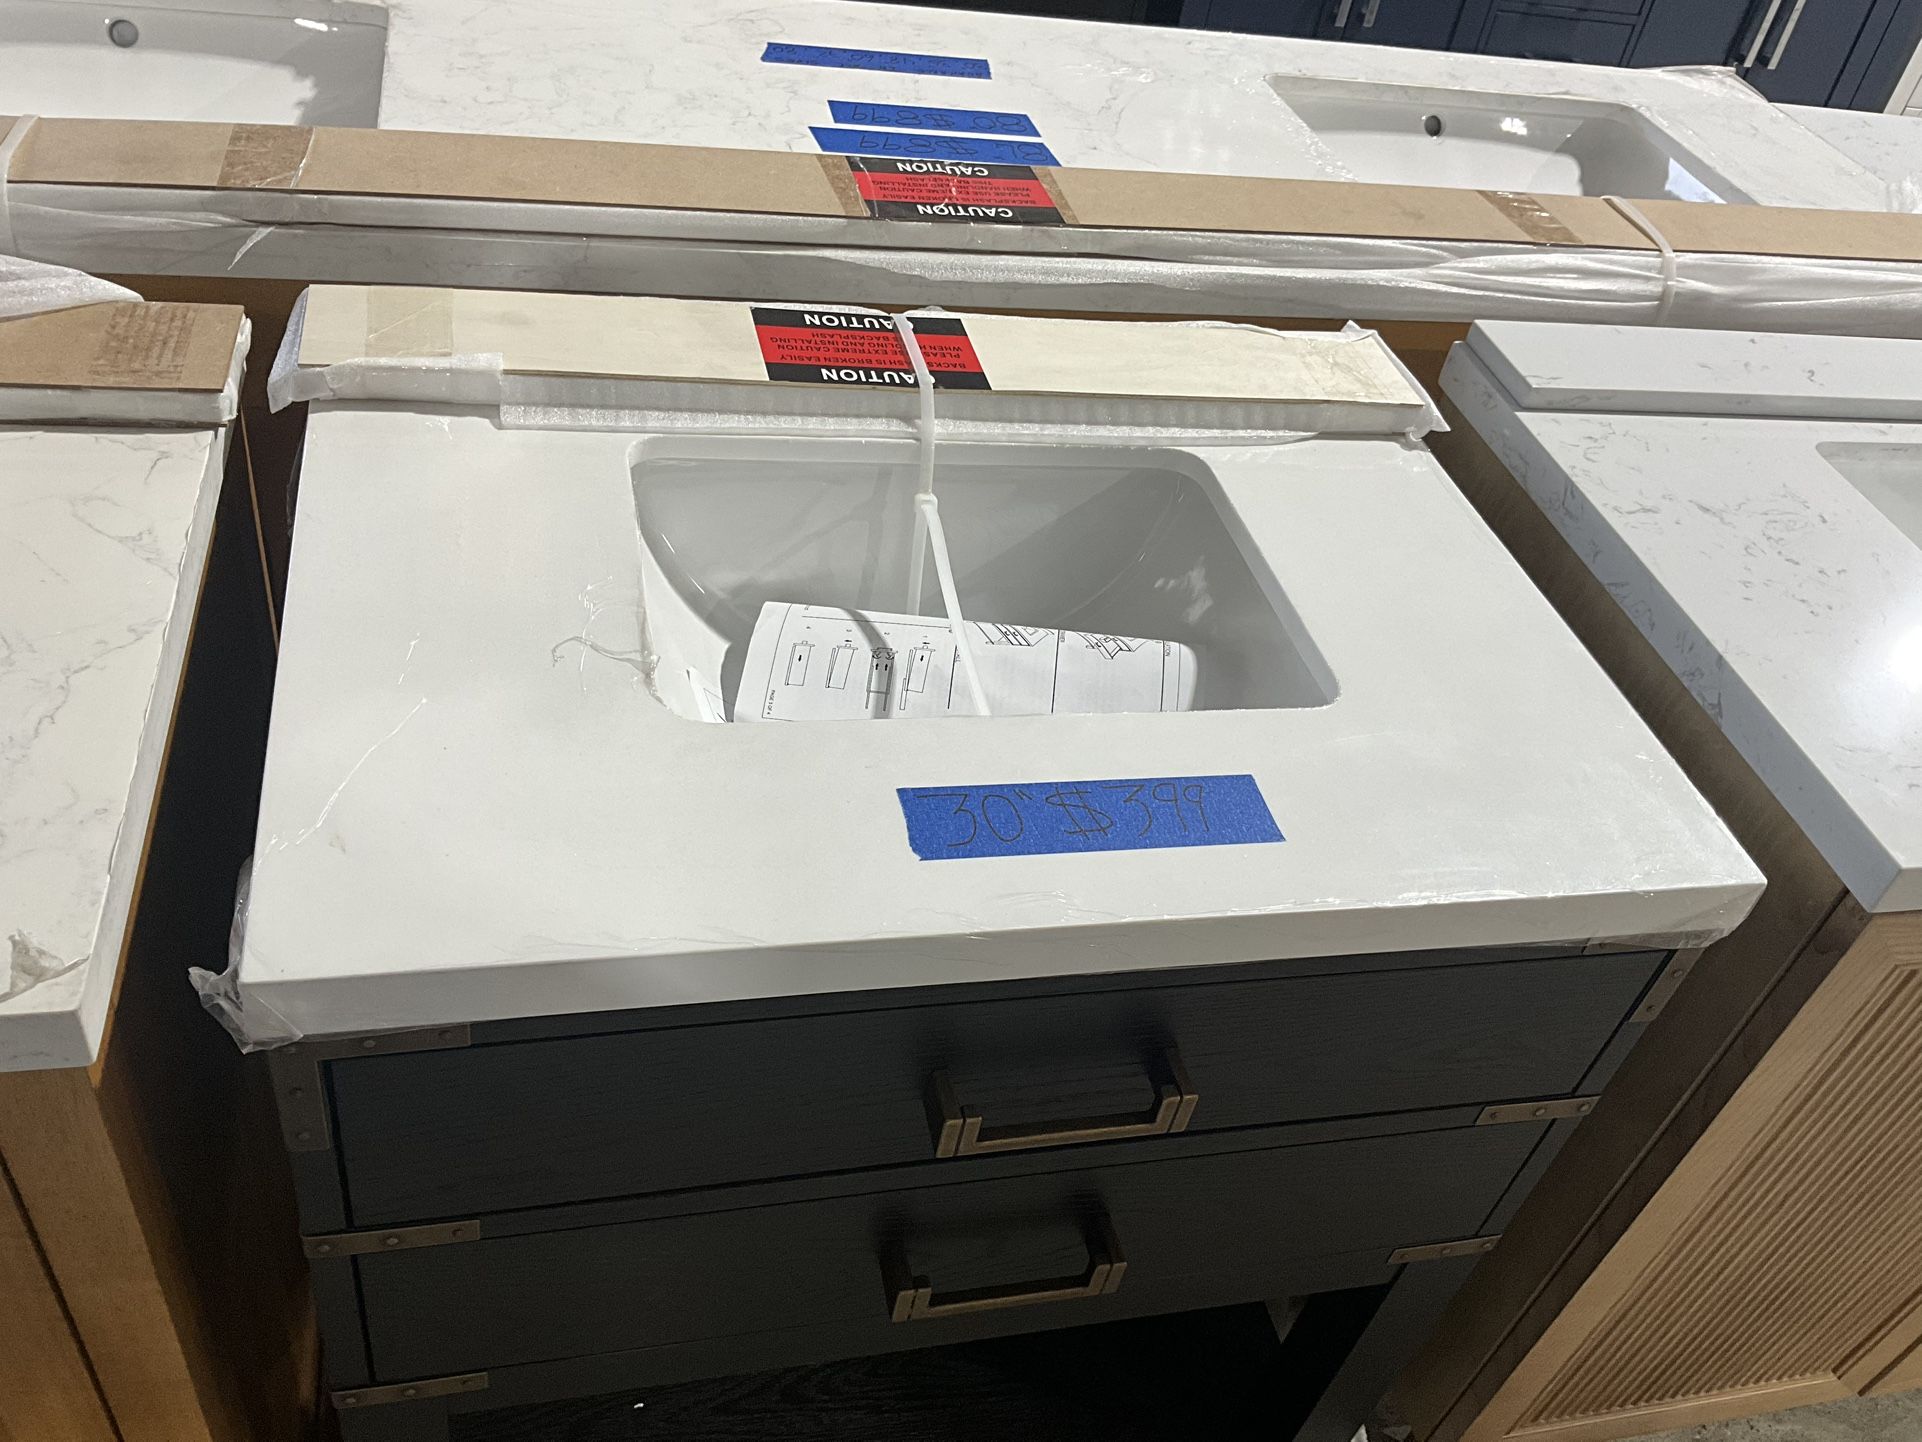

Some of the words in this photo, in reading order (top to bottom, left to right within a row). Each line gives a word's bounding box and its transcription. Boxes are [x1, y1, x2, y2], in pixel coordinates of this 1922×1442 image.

[851, 105, 955, 129] $899
[860, 136, 977, 156] $899
[896, 162, 988, 176] CAUTION
[872, 180, 928, 188] INSTALLING
[917, 204, 1013, 218] CAUTION
[812, 332, 889, 341] BACKSPLASH
[770, 337, 839, 346] INSTALLING
[777, 344, 830, 352] CAUTION
[834, 347, 888, 355] EXTREME
[780, 354, 820, 362] EASILY
[923, 351, 960, 359] PLEAS
[917, 789, 1033, 847] 30"
[1045, 783, 1209, 840] $399
